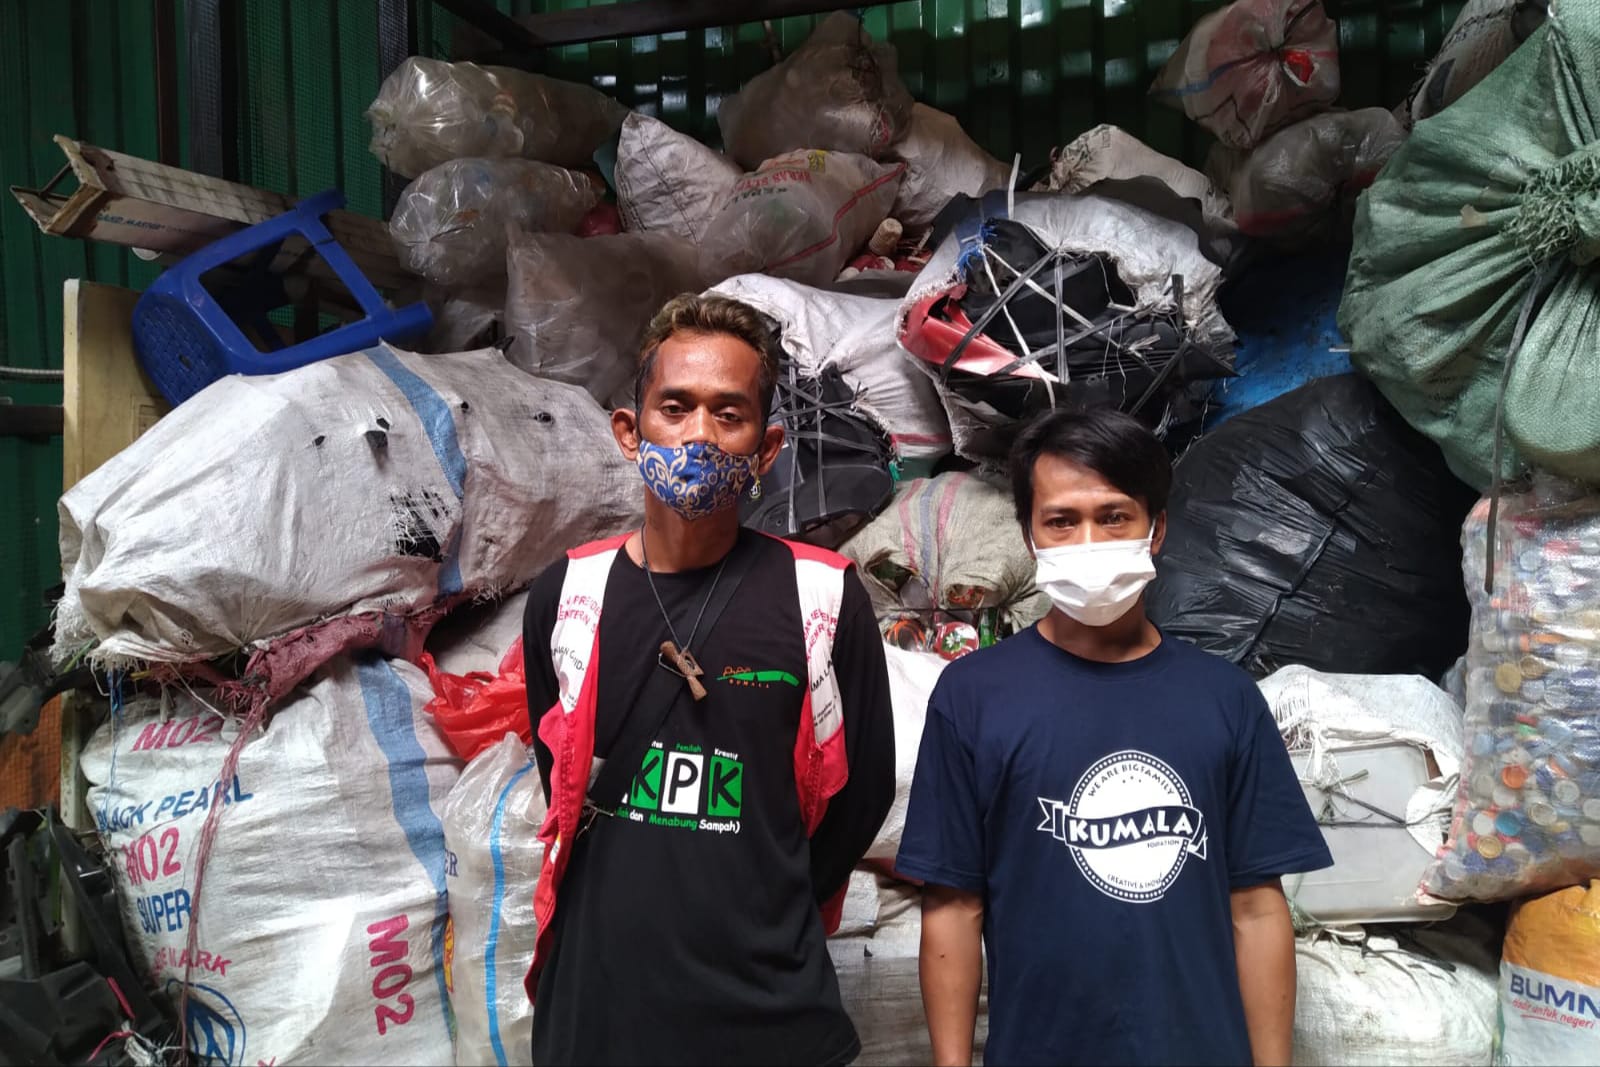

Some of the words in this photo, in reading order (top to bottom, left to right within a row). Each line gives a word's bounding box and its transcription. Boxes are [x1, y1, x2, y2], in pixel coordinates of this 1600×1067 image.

[1101, 767, 1120, 783] ARE
[154, 774, 254, 822] PEARL
[629, 809, 644, 822] dan
[649, 815, 698, 832] Menabung
[699, 818, 741, 835] Sampah)
[1069, 809, 1194, 847] KUMALA
[136, 888, 193, 934] SUPER
[1510, 973, 1600, 1020] BUMN
[1559, 1014, 1596, 1030] negeri
